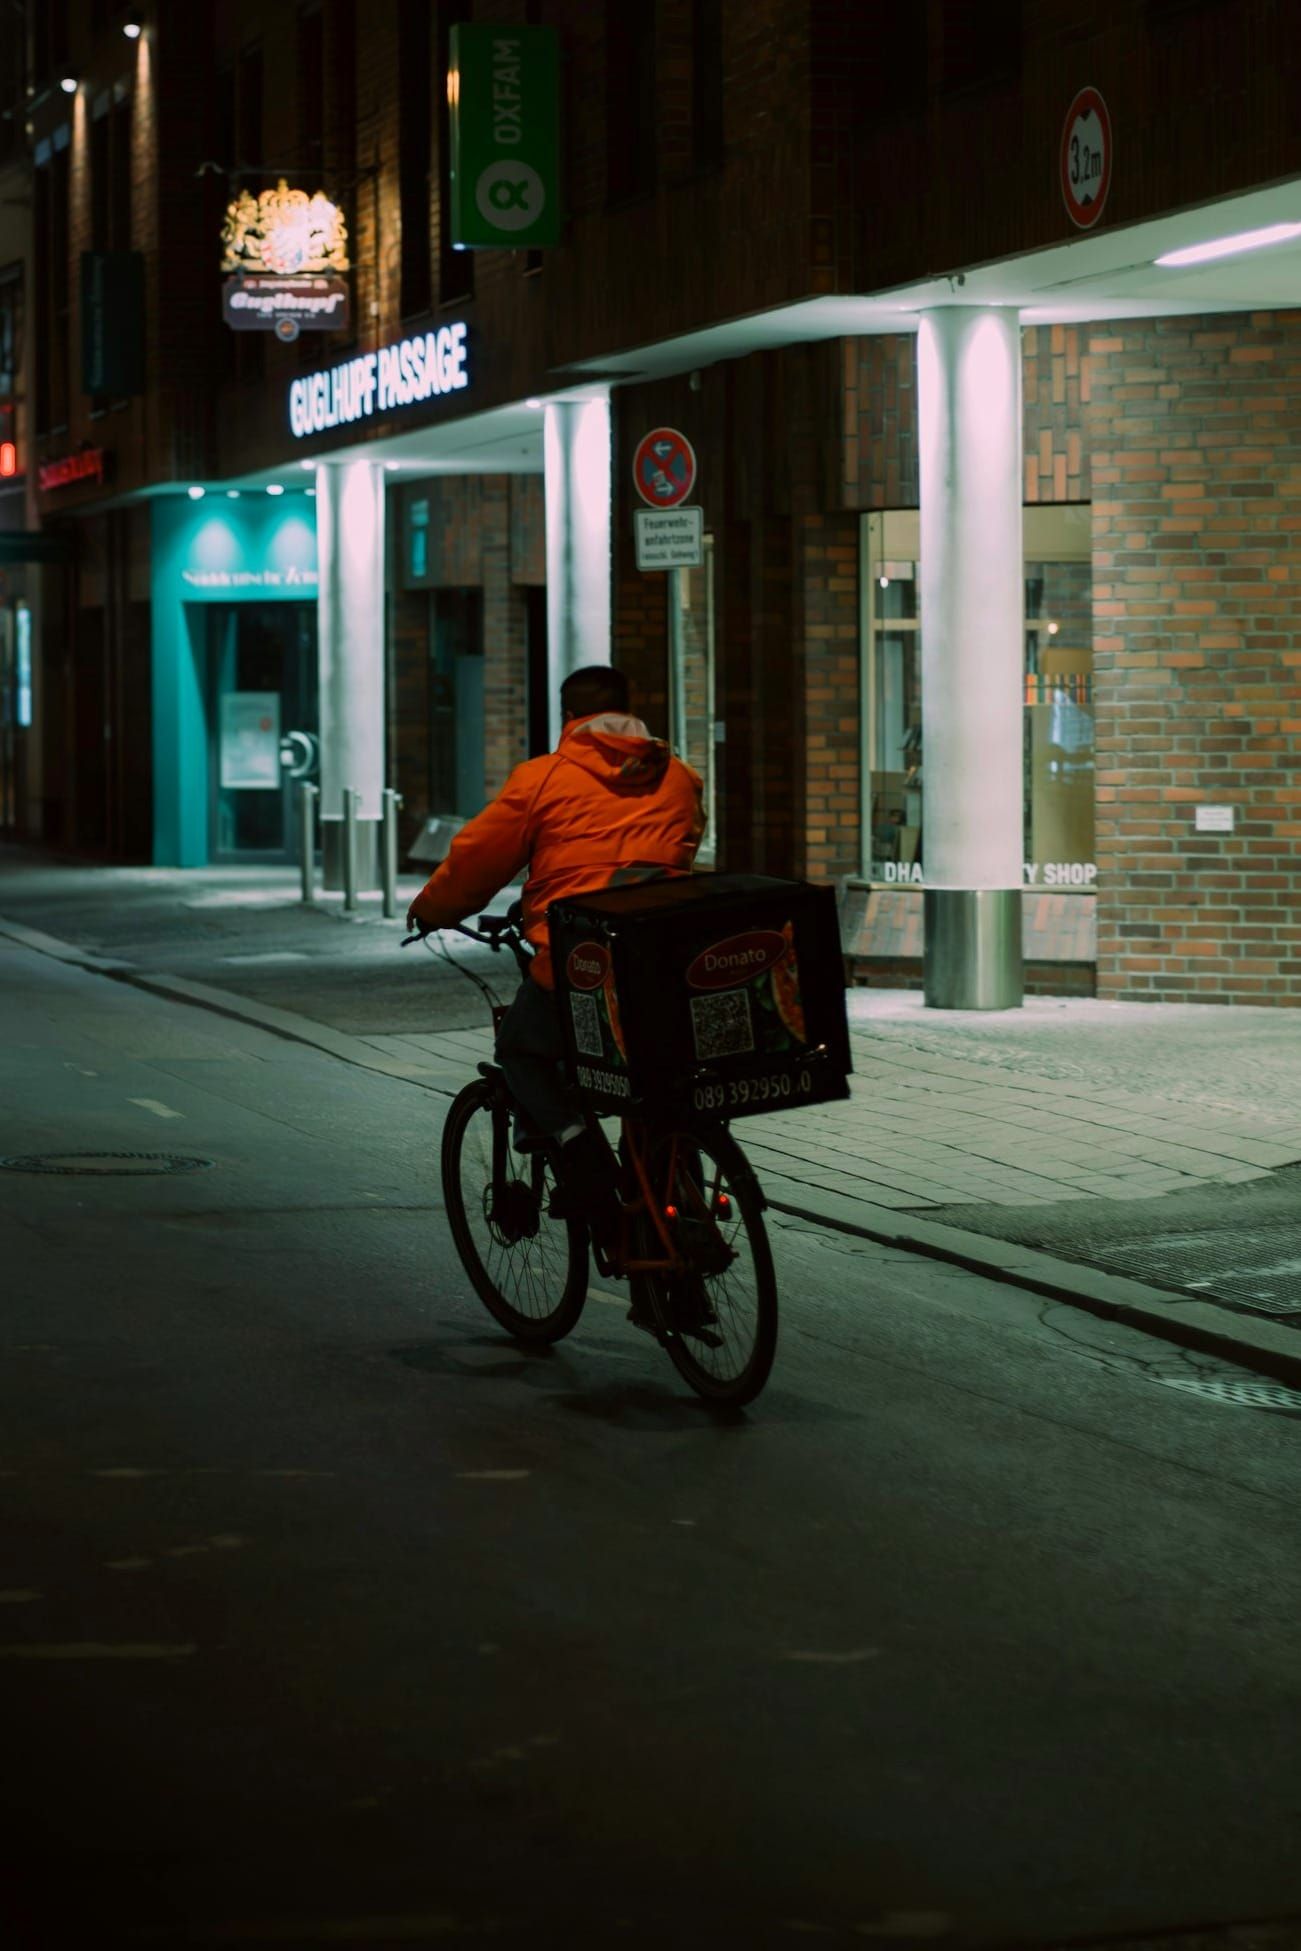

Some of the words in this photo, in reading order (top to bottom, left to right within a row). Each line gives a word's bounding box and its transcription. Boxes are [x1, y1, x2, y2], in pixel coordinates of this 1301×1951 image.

[493, 38, 521, 144] OXFAM
[289, 353, 377, 438] GUGLHUPF
[377, 321, 468, 410] PASSAGE
[883, 861, 924, 882] DHA
[1043, 862, 1098, 885] SHOP
[704, 948, 767, 972] Donato
[693, 1084, 725, 1111] 089
[728, 1069, 812, 1105] 3929500
